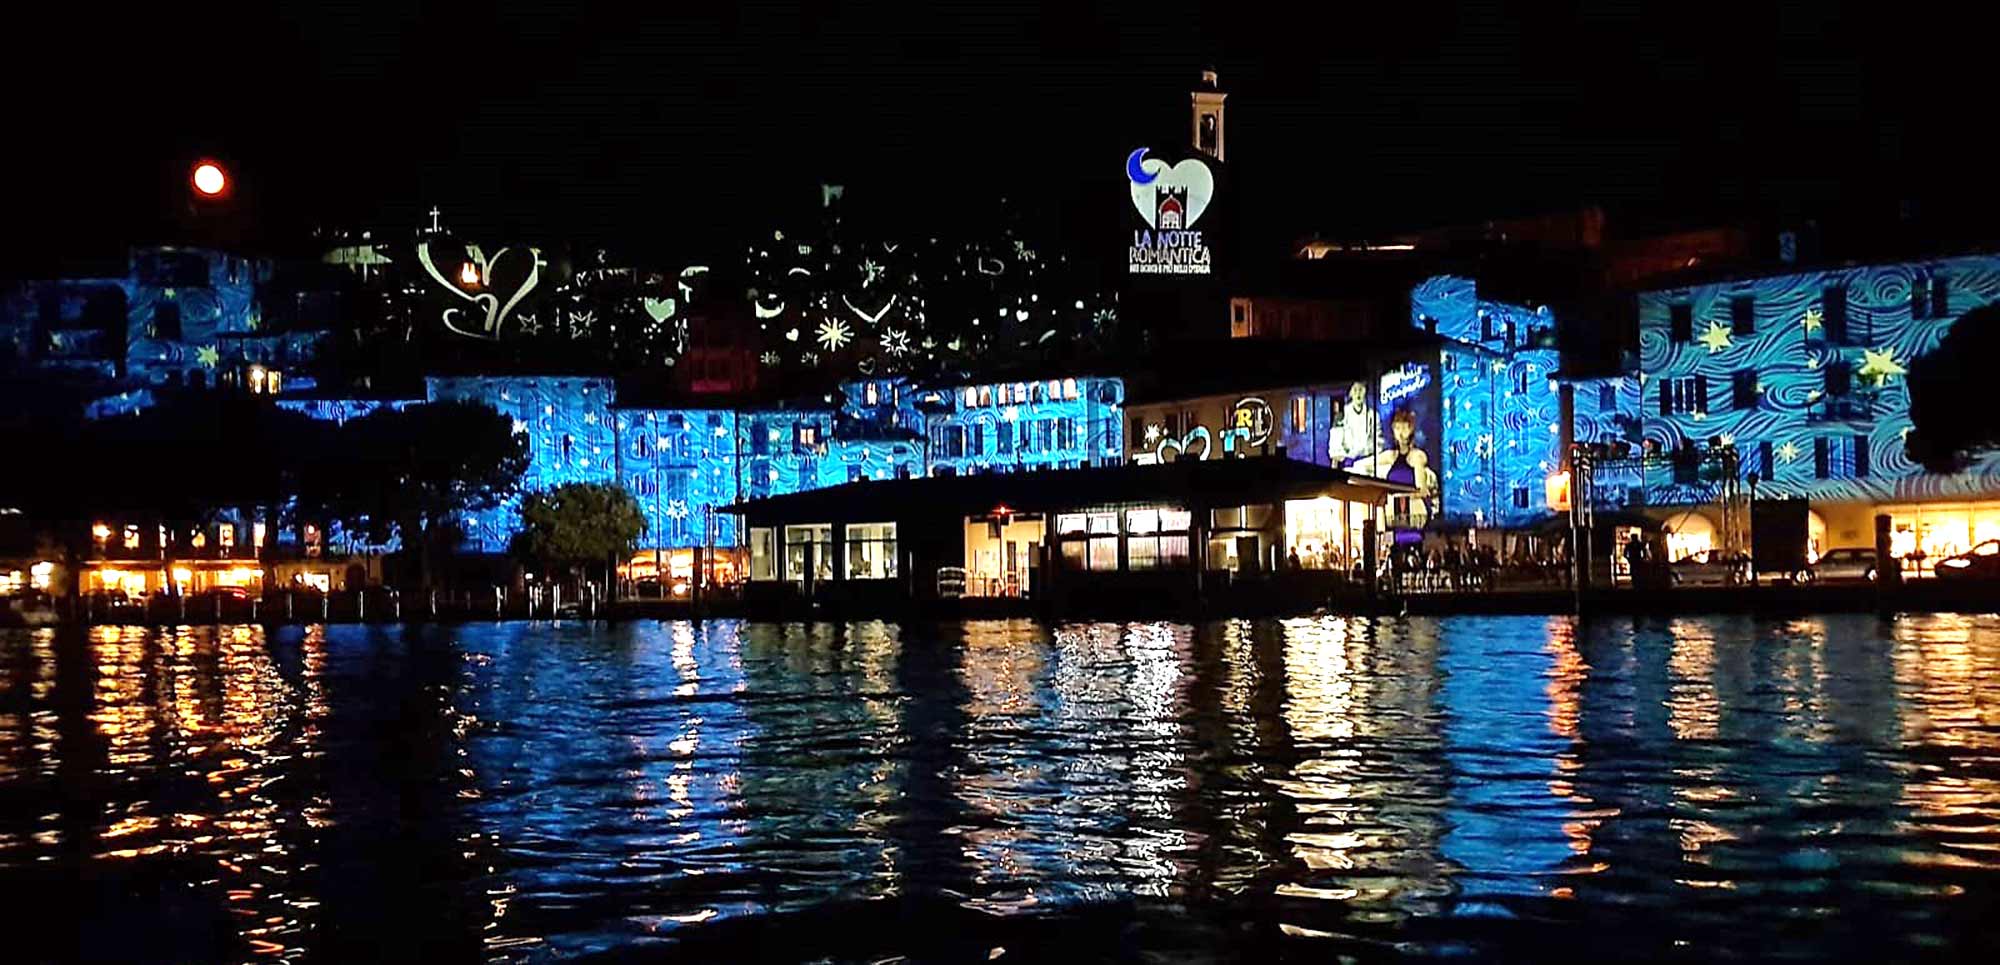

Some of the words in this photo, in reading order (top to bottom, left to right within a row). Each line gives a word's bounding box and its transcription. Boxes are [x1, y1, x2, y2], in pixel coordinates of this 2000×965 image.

[1134, 229, 1151, 248] LA
[1157, 230, 1202, 249] NOTTE
[1129, 246, 1211, 264] ROMANTICA
